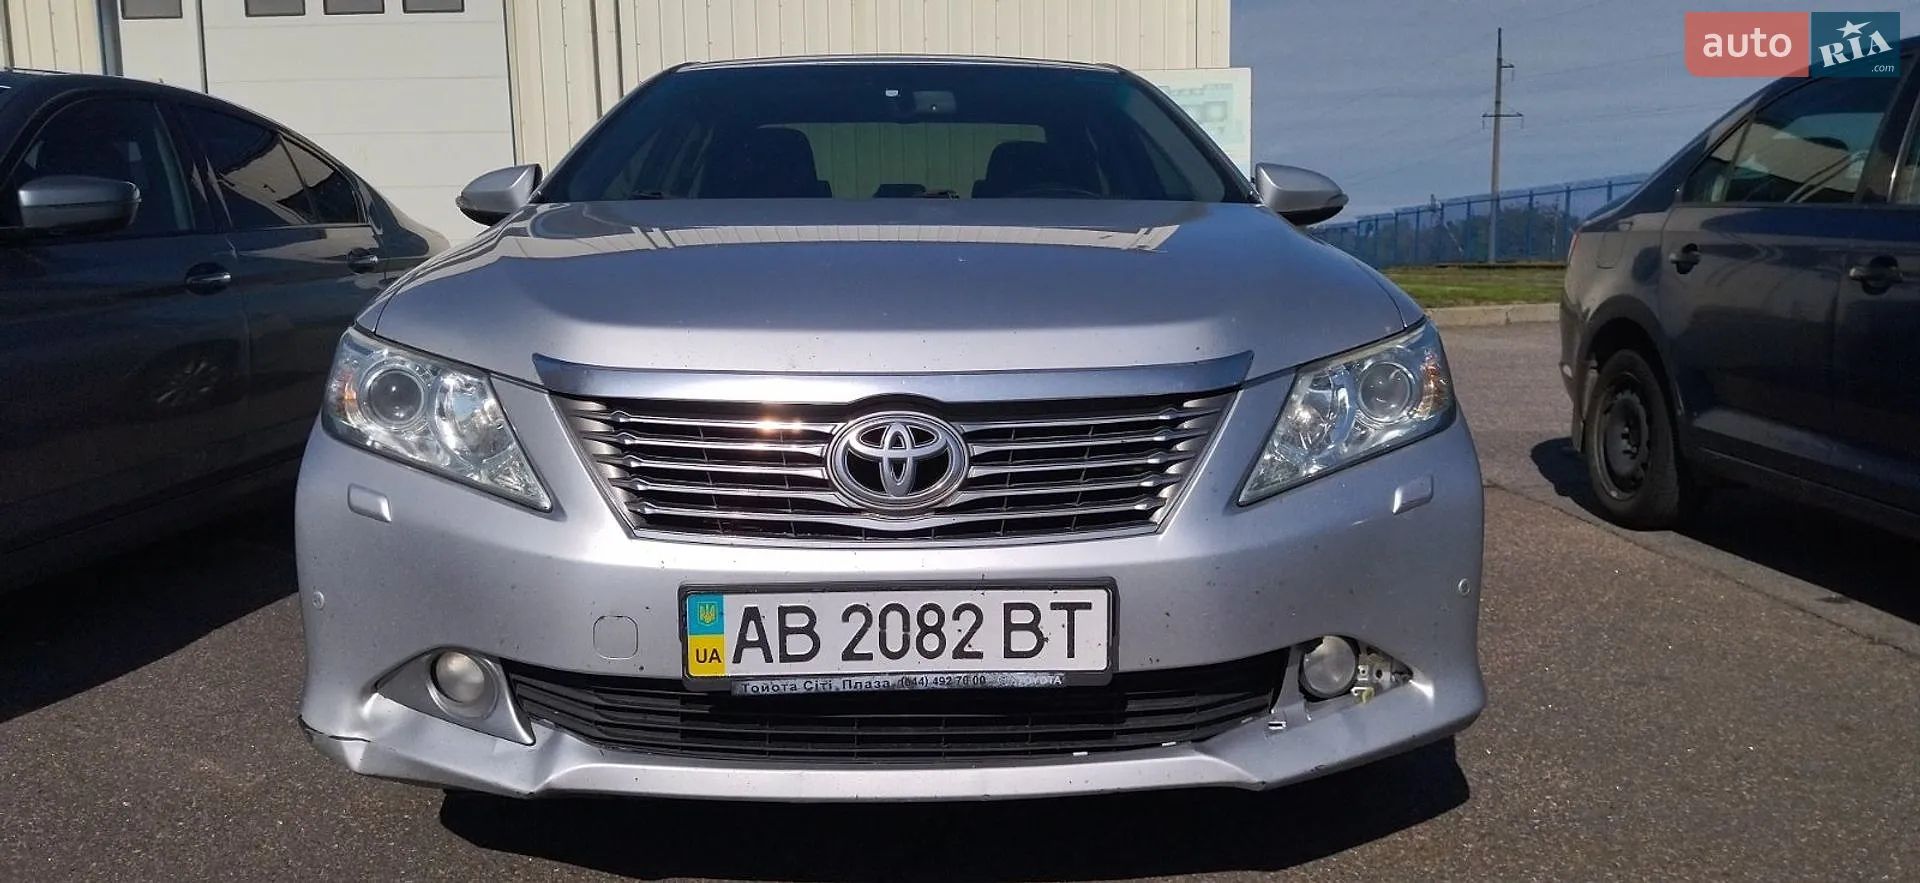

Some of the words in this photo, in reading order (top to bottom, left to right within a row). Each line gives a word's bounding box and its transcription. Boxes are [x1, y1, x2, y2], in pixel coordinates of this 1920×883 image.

[732, 605, 821, 664] AB
[841, 602, 984, 661] 2082
[1003, 601, 1092, 659] BT
[696, 649, 722, 664] UA
[932, 676, 952, 686] 492
